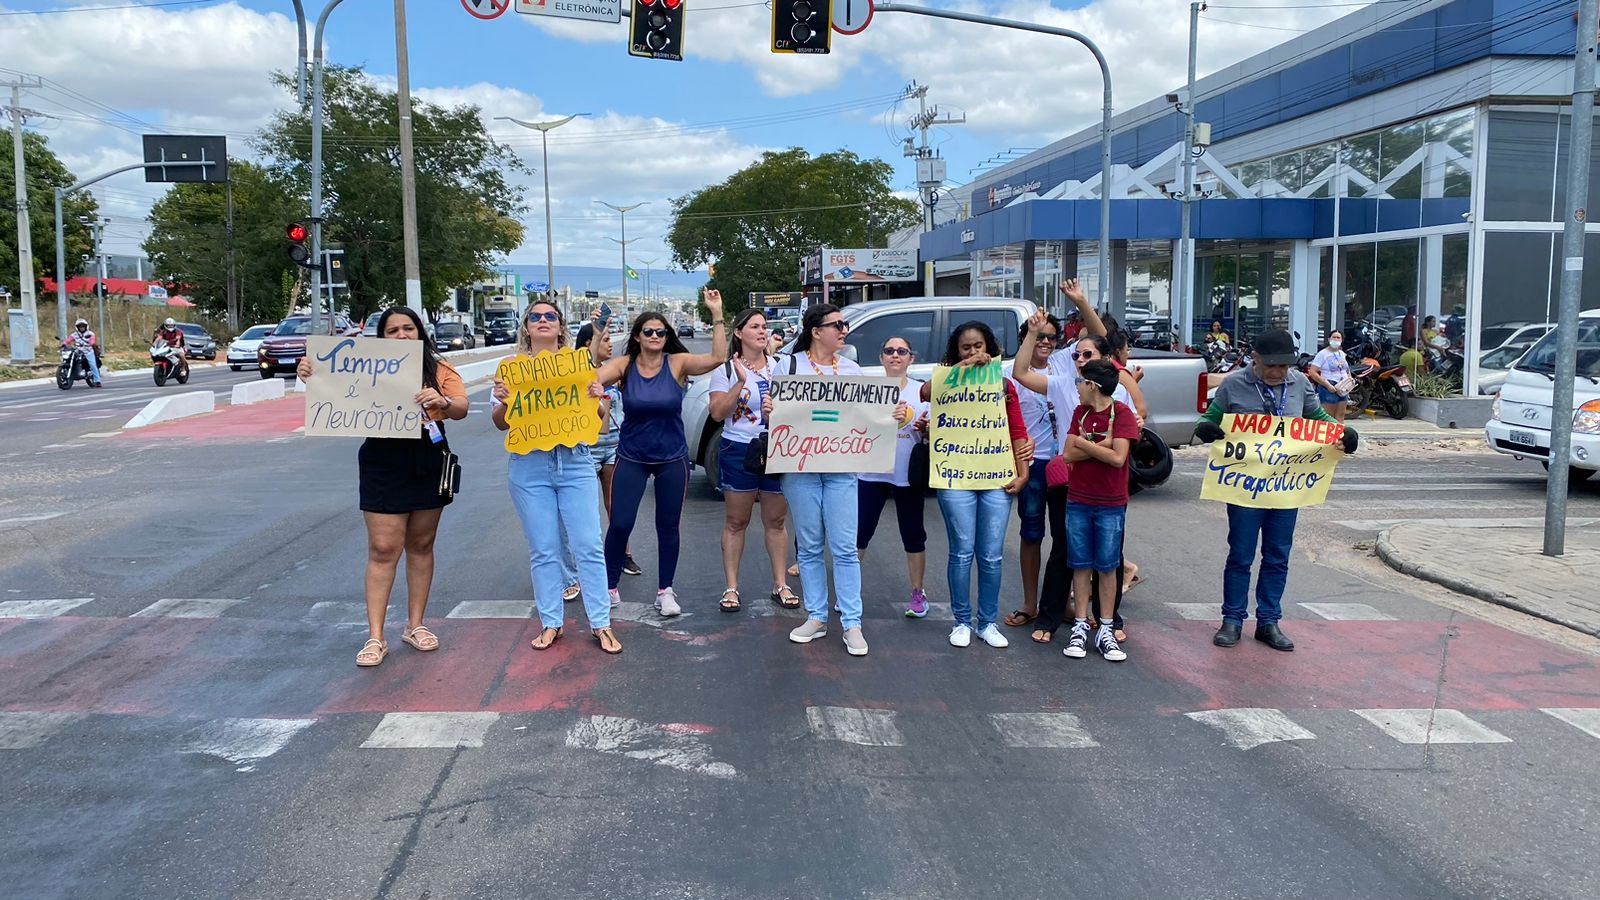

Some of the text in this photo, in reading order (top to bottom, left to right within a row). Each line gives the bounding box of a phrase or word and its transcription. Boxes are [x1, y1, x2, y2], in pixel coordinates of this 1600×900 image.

[555, 2, 614, 15] ELETRÔNICA
[830, 254, 856, 264] FGTS
[317, 339, 411, 386] Tempo
[499, 349, 597, 387] REMANEJAR
[344, 379, 359, 398] é
[770, 380, 900, 405] DESCREDENCIAMENTO
[508, 383, 580, 420] ATRASA
[508, 409, 591, 446] EVOLUÇÃO
[937, 412, 1007, 429] Baixa estrutu
[768, 424, 881, 471] Regressão
[934, 437, 1009, 456] Especialidades
[1224, 441, 1246, 460] DO
[935, 460, 1014, 488] Vagas semanais
